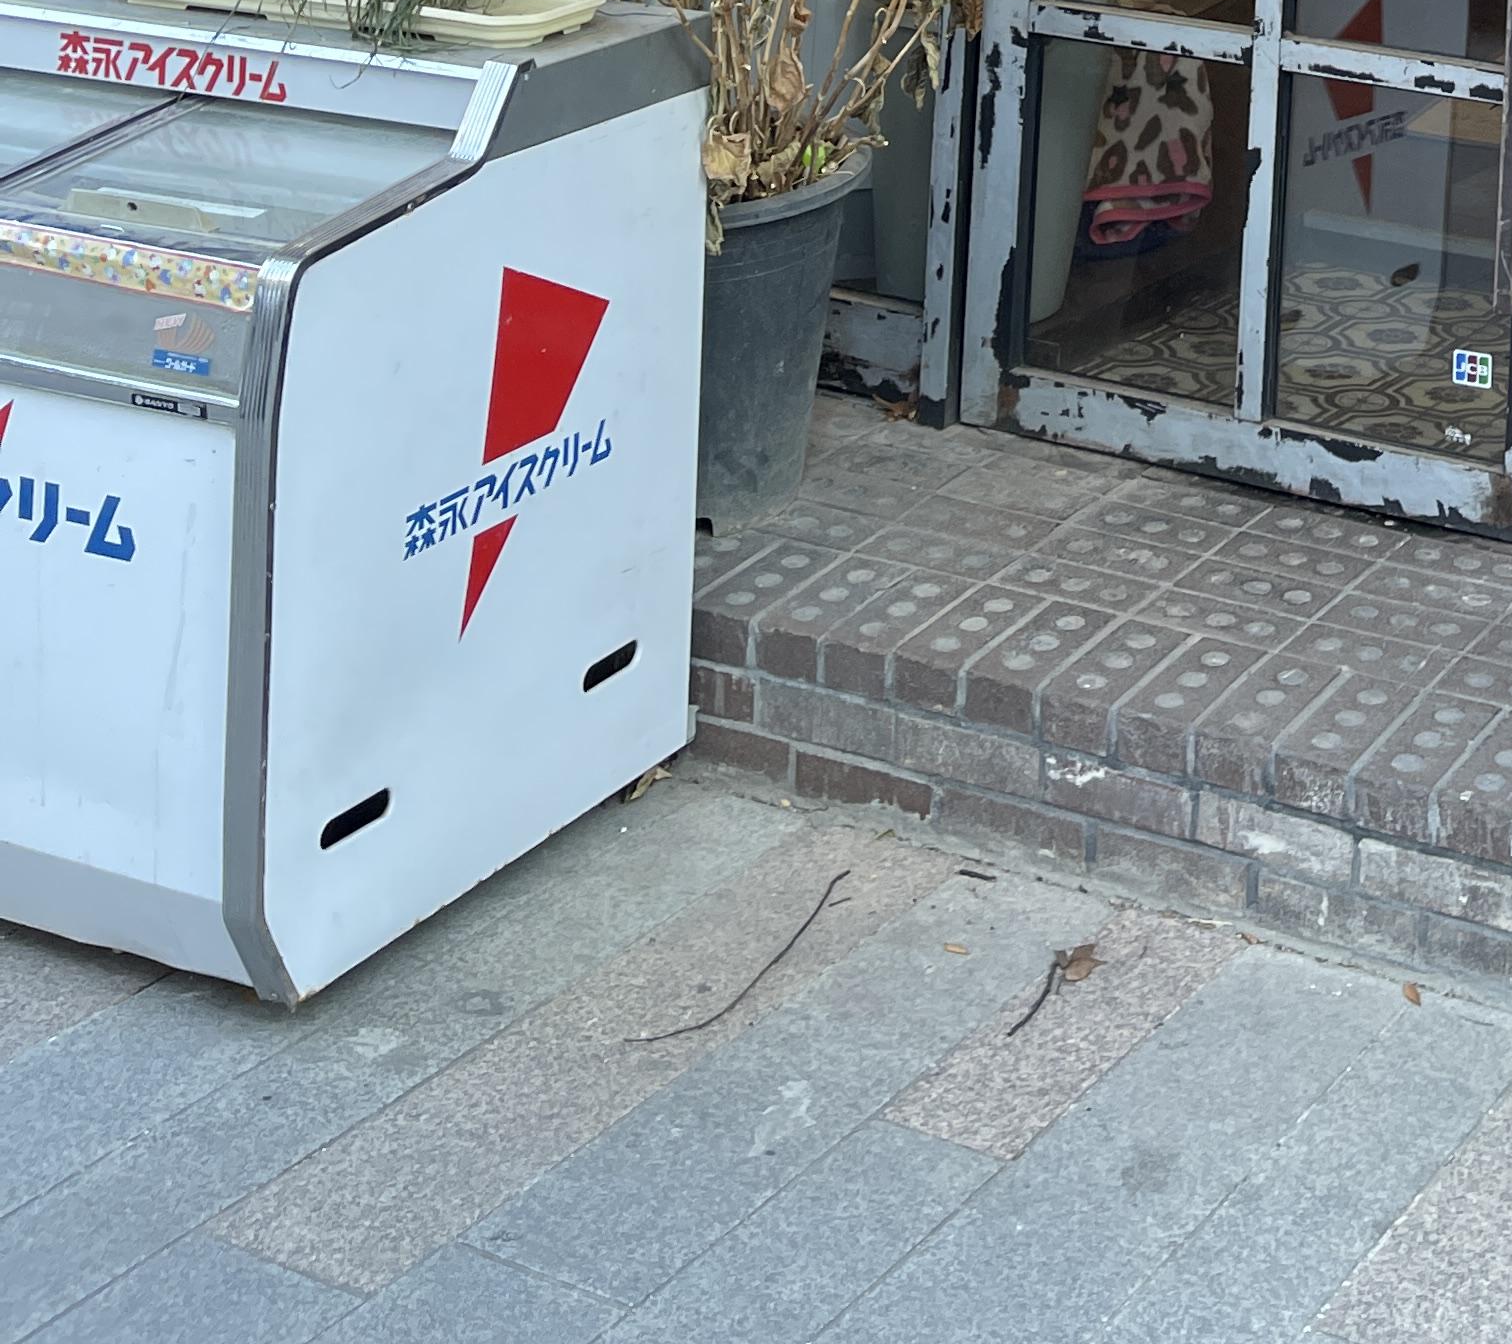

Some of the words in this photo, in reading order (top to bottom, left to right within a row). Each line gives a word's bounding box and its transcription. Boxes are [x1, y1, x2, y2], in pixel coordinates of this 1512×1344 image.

[57, 30, 288, 103] 森永アイスクリーム
[0, 476, 136, 562] リーム
[403, 418, 612, 561] 森永アイスクリーム
